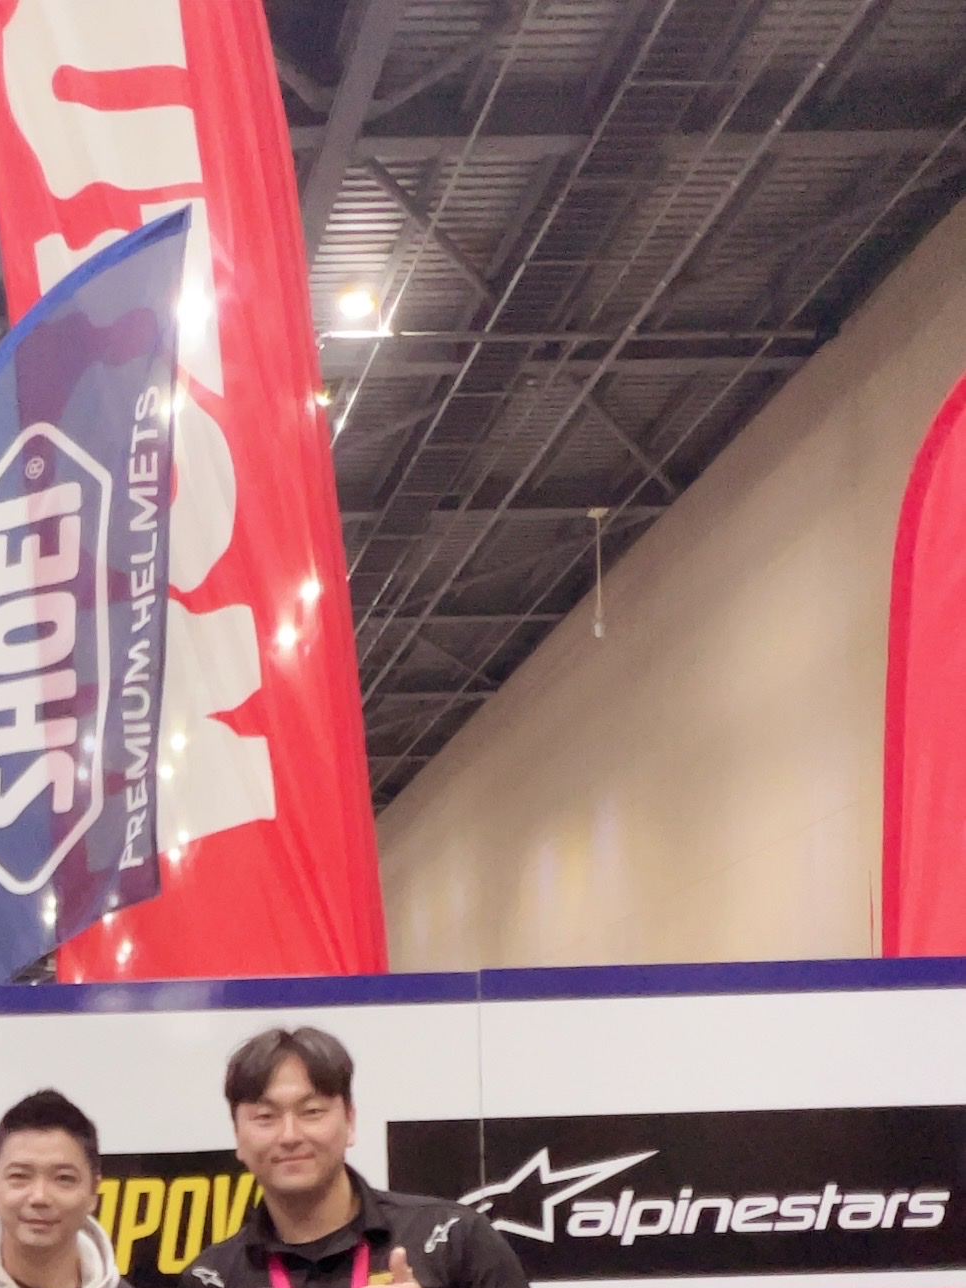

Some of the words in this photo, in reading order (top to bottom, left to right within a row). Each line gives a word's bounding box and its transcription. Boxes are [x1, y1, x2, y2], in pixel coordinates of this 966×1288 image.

[132, 387, 162, 627] HELMETS
[119, 639, 153, 868] PREMIUM
[566, 1183, 951, 1247] alpinestars
